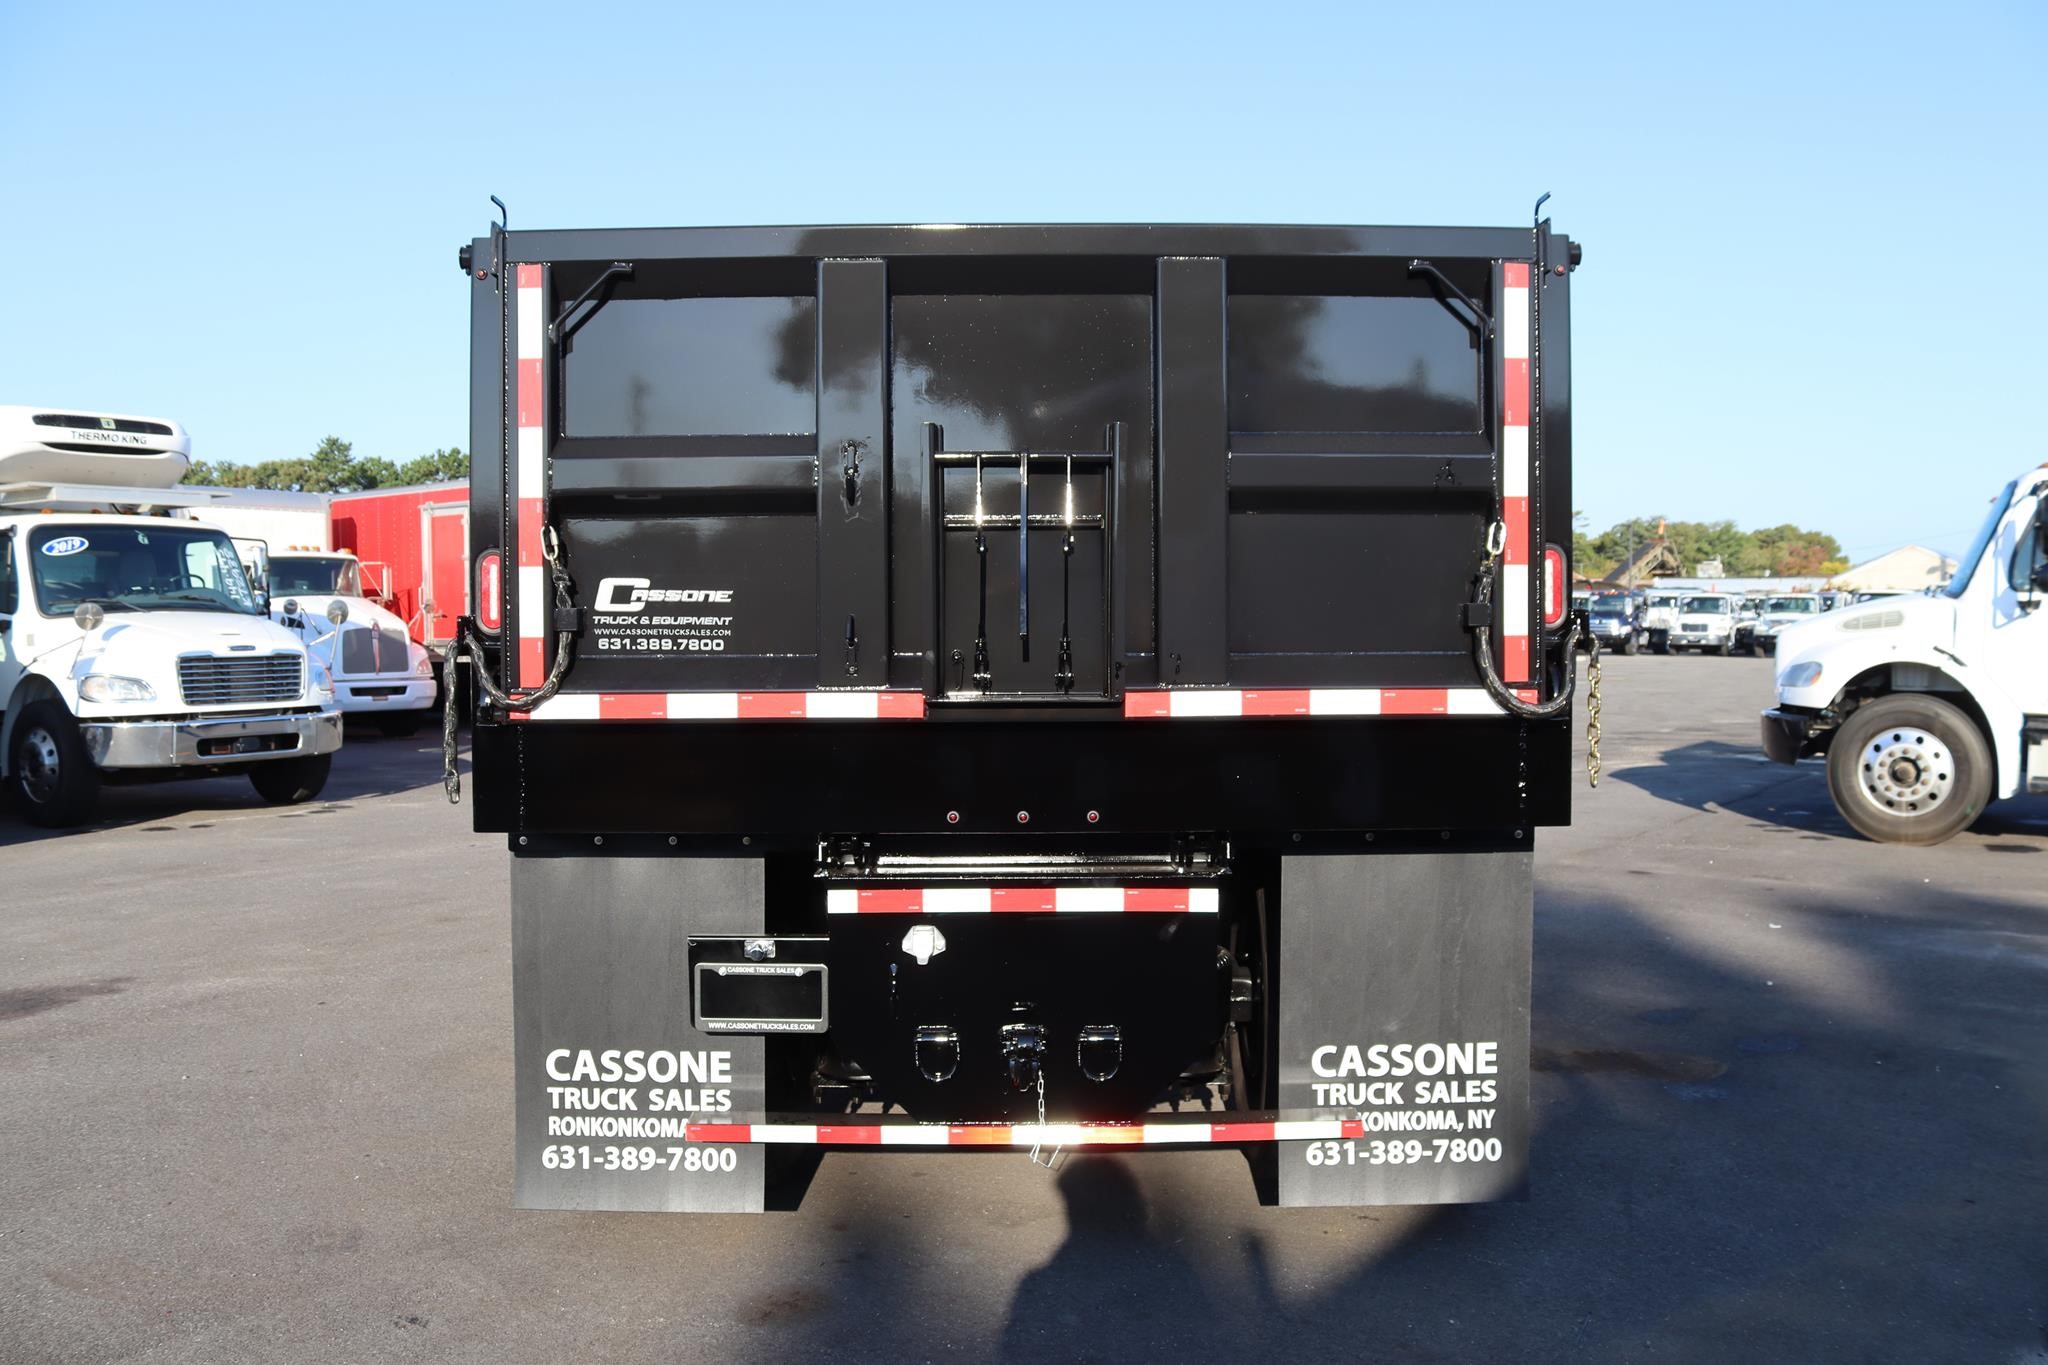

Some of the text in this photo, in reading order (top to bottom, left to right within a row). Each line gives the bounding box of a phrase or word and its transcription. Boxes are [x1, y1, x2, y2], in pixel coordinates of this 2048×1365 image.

[71, 430, 147, 445] THERMO KING
[52, 537, 82, 554] 2019
[594, 577, 734, 612] CASSONE
[592, 615, 733, 626] TRUCK & EQUIPMENT
[594, 628, 731, 636] WWW.CASSONETRUCKSALES.COM
[598, 638, 725, 651] 631.389.7800
[708, 1022, 815, 1031] WWW.CASSONETRUCKSALES.COM
[545, 1049, 732, 1083] CASSONE
[1311, 1042, 1498, 1078] CASSONE
[547, 1087, 732, 1112] TRUCK SALES
[1312, 1080, 1497, 1106] TRUCK SALES
[1357, 1109, 1496, 1132] KONKOMA, NY
[542, 1145, 737, 1172] 631-389-7800
[1306, 1138, 1502, 1166] 631-389-7800
